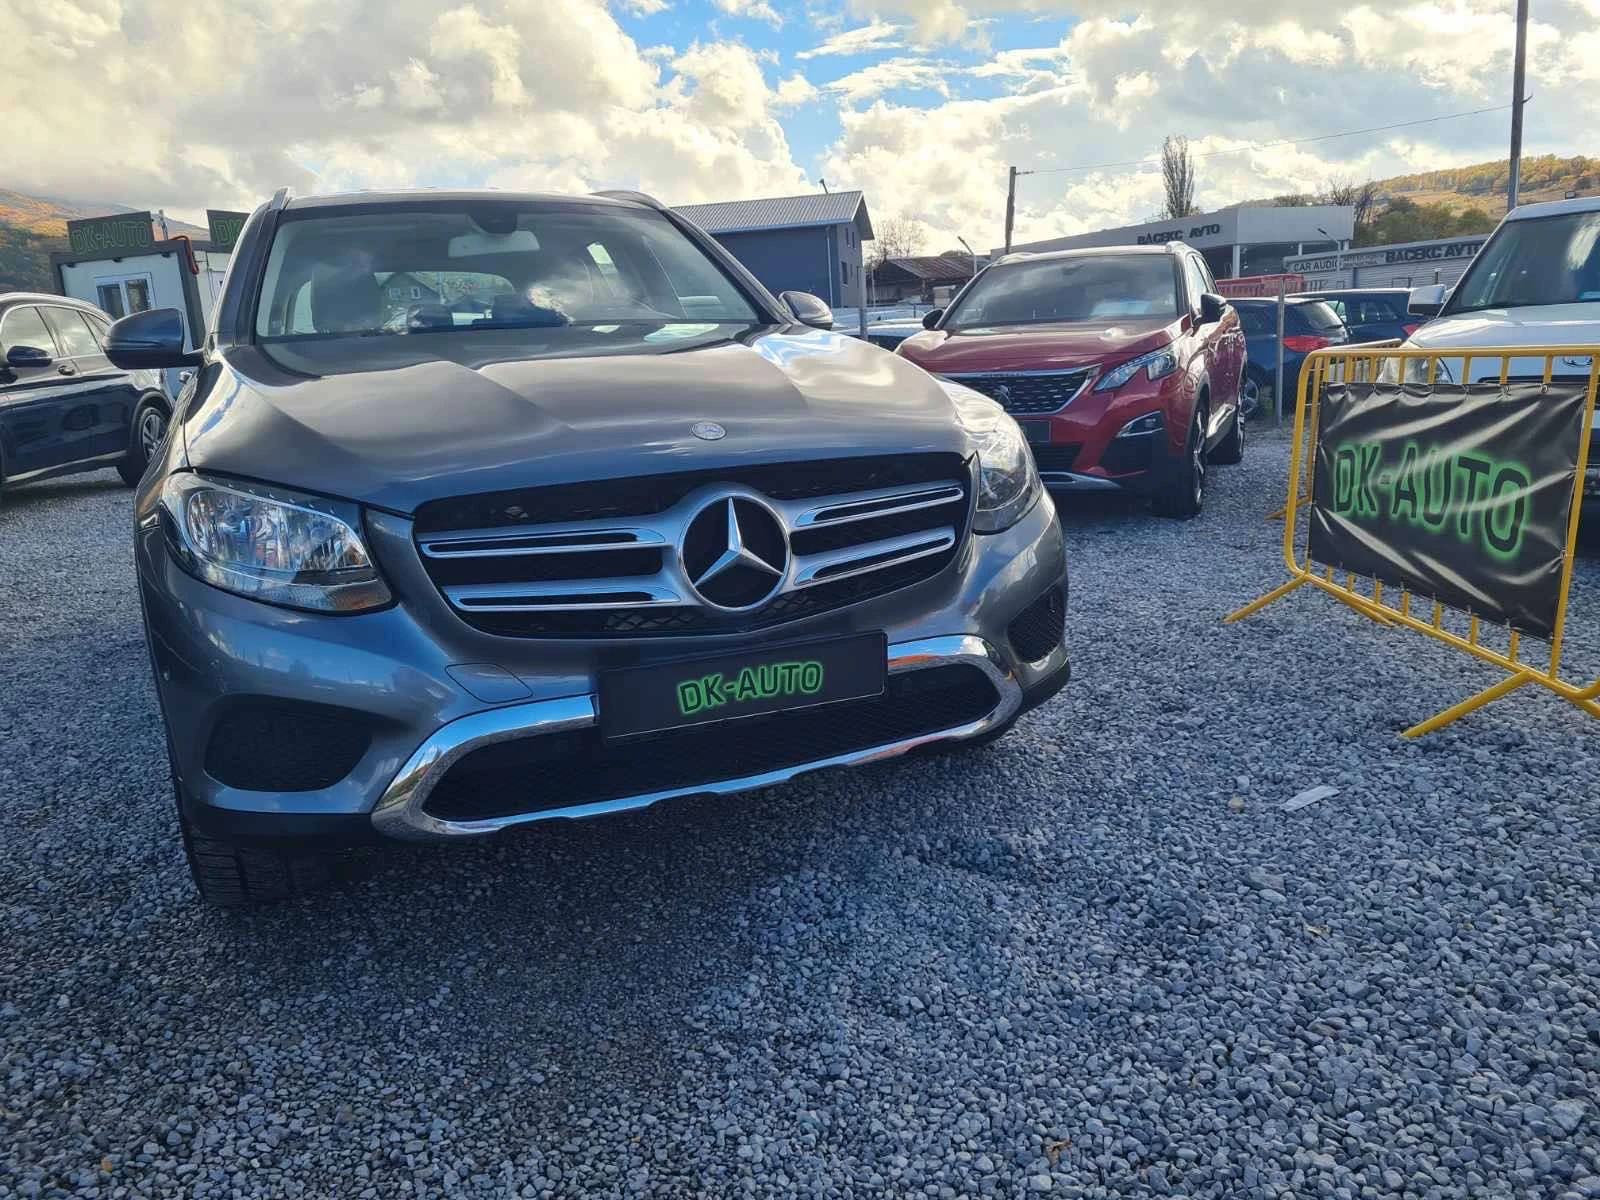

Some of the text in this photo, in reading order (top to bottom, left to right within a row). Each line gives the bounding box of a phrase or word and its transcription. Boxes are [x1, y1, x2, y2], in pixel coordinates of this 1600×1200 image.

[71, 220, 150, 255] DK-AUTO
[1294, 262, 1311, 272] CAR
[1334, 442, 1530, 556] DK-AUTO
[678, 662, 823, 714] DK-AUTO
